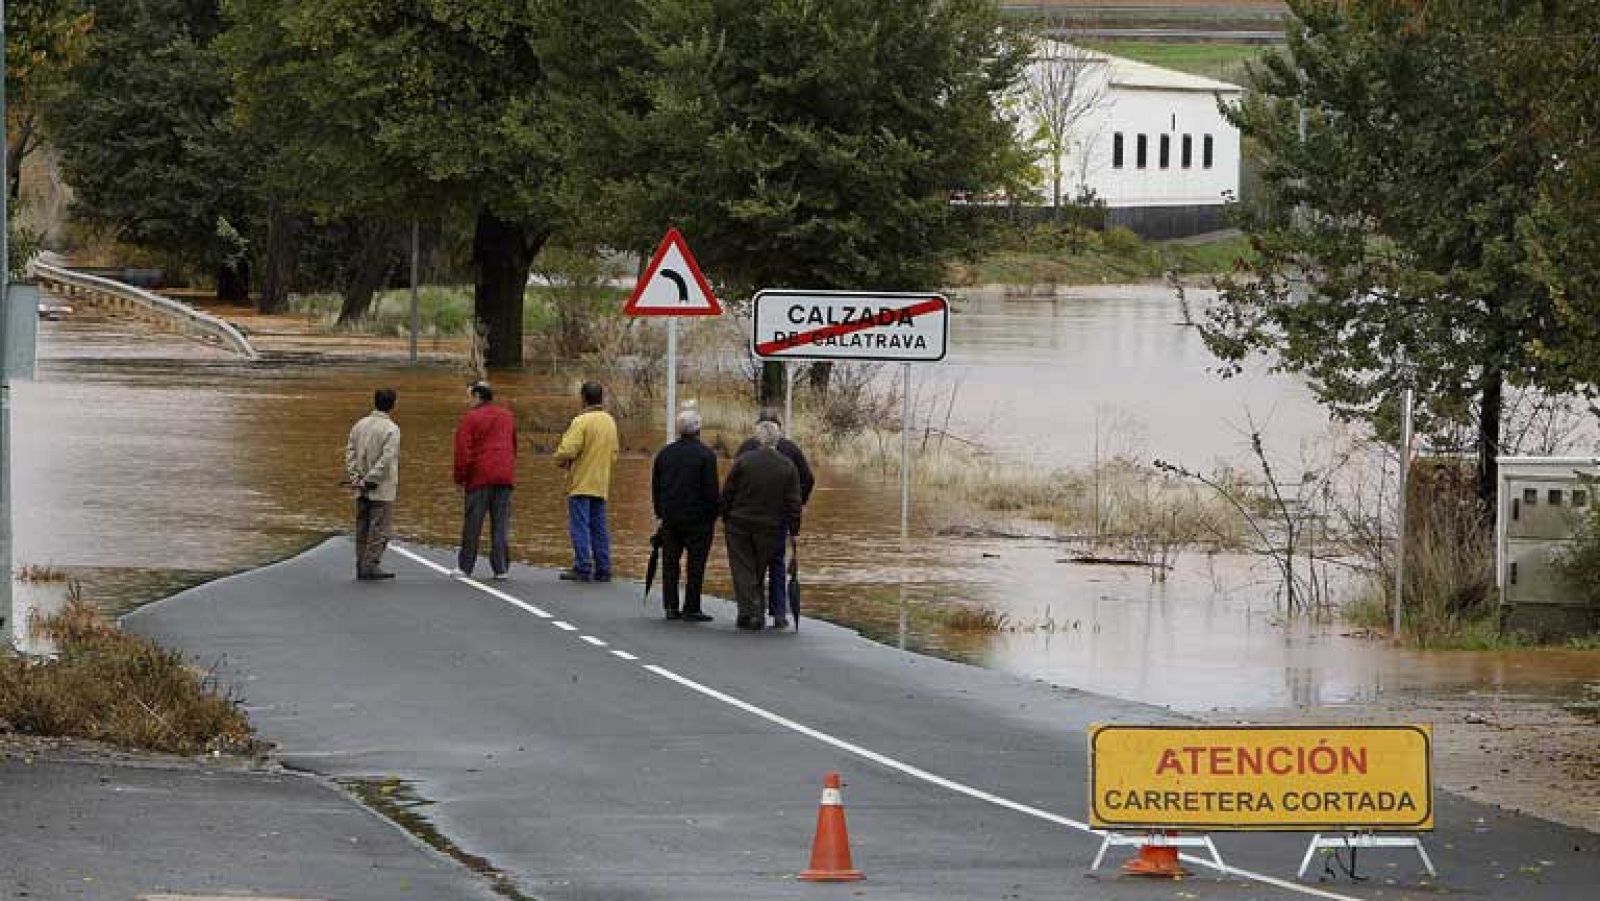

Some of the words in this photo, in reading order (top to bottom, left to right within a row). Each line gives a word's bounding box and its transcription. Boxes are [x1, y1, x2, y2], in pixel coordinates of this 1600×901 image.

[787, 304, 914, 327] CALZADA
[1155, 738, 1368, 775] ATENCIÓN
[1104, 790, 1274, 811] CARRETERA
[1282, 791, 1417, 812] CORTADA
